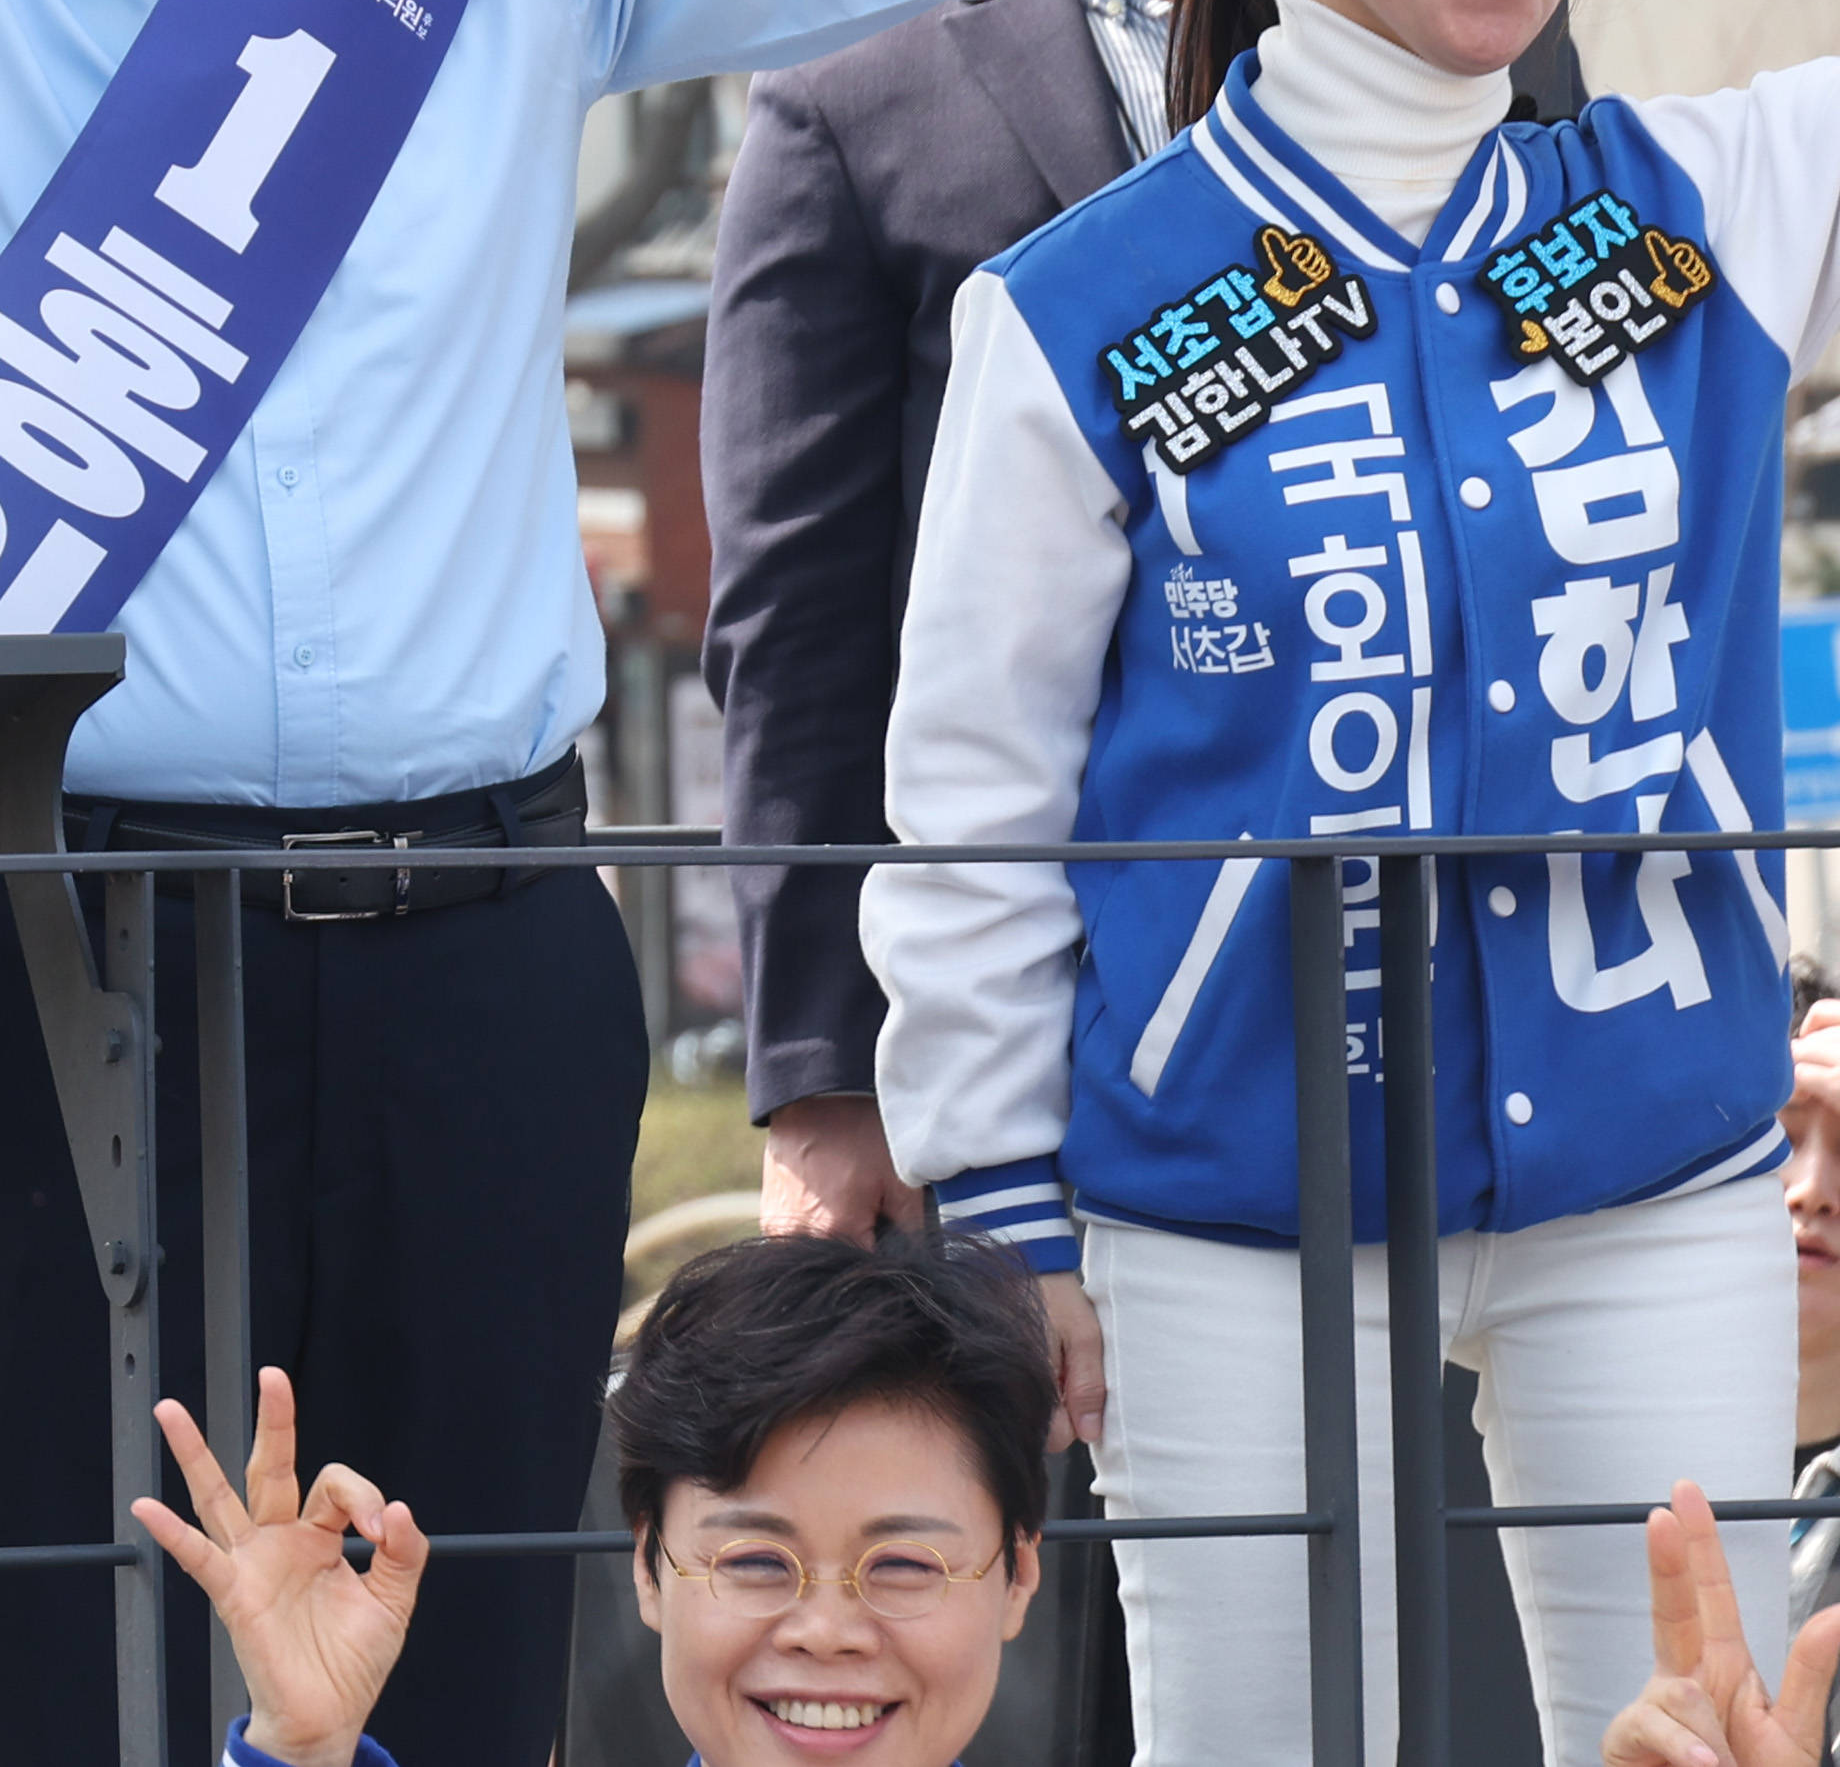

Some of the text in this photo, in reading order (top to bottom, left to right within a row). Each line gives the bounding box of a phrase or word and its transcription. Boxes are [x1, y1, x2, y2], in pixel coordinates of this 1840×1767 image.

[154, 28, 337, 254] 1
[1487, 192, 1640, 315] 후보자
[1106, 268, 1277, 401] 서초갑
[1126, 279, 1370, 464] 김한나TV
[1542, 268, 1668, 376] 본인
[1163, 578, 1239, 620] 민주당
[1170, 621, 1276, 675] 서초갑
[1488, 346, 1713, 1012] 김한나
